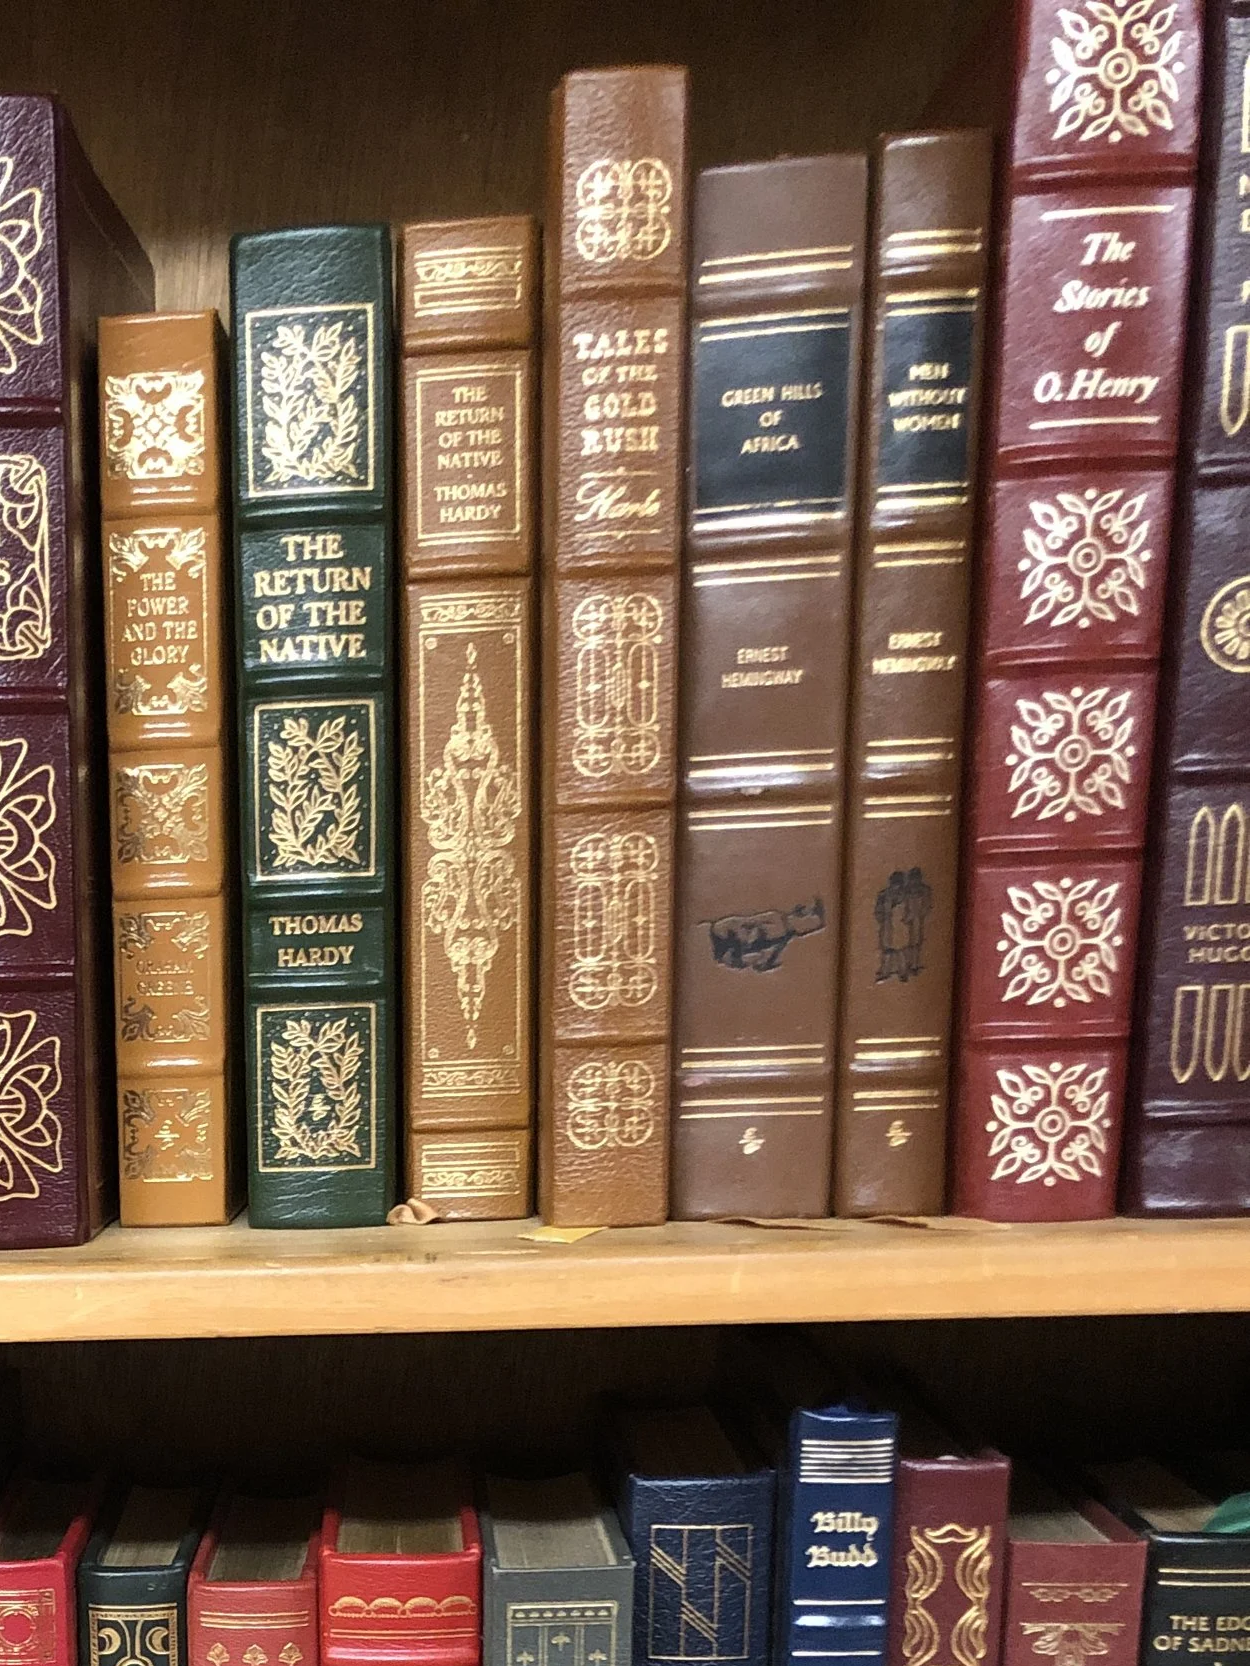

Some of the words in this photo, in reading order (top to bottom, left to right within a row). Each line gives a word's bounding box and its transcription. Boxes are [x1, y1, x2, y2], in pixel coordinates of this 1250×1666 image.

[1080, 232, 1136, 266] The
[1053, 277, 1152, 313] Stories
[573, 328, 668, 360] TALES
[1084, 321, 1123, 358] of
[582, 365, 611, 387] OF
[615, 364, 658, 383] THE
[452, 386, 487, 403] THE
[721, 386, 774, 407] GREEN
[781, 382, 823, 402] HILLS
[435, 407, 504, 427] RETURN
[583, 392, 657, 421] GOLD
[759, 410, 784, 428] OF
[438, 432, 463, 448] OF
[467, 430, 502, 446] THE
[580, 425, 660, 456] RUSH
[740, 435, 801, 455] AFRICA
[437, 452, 503, 470] NATIVE
[434, 482, 507, 501] THOMAS
[440, 505, 502, 523] HARDY
[280, 534, 344, 562] THE
[140, 571, 176, 592] THE
[254, 567, 372, 598] RETURN
[126, 595, 189, 617] POWER
[256, 605, 295, 631] OF
[303, 600, 367, 627] THE
[122, 621, 156, 642] AND
[162, 621, 197, 641] THE
[131, 643, 189, 665] GLORY
[259, 632, 367, 664] NATIVE
[737, 646, 790, 665] ERNEST
[721, 669, 803, 688] HEMINGWAY
[268, 914, 363, 935] THOMAS
[277, 946, 354, 968] HARDY
[810, 1512, 880, 1542] Billy
[1169, 1615, 1211, 1632] THE
[1153, 1635, 1183, 1651] OF
